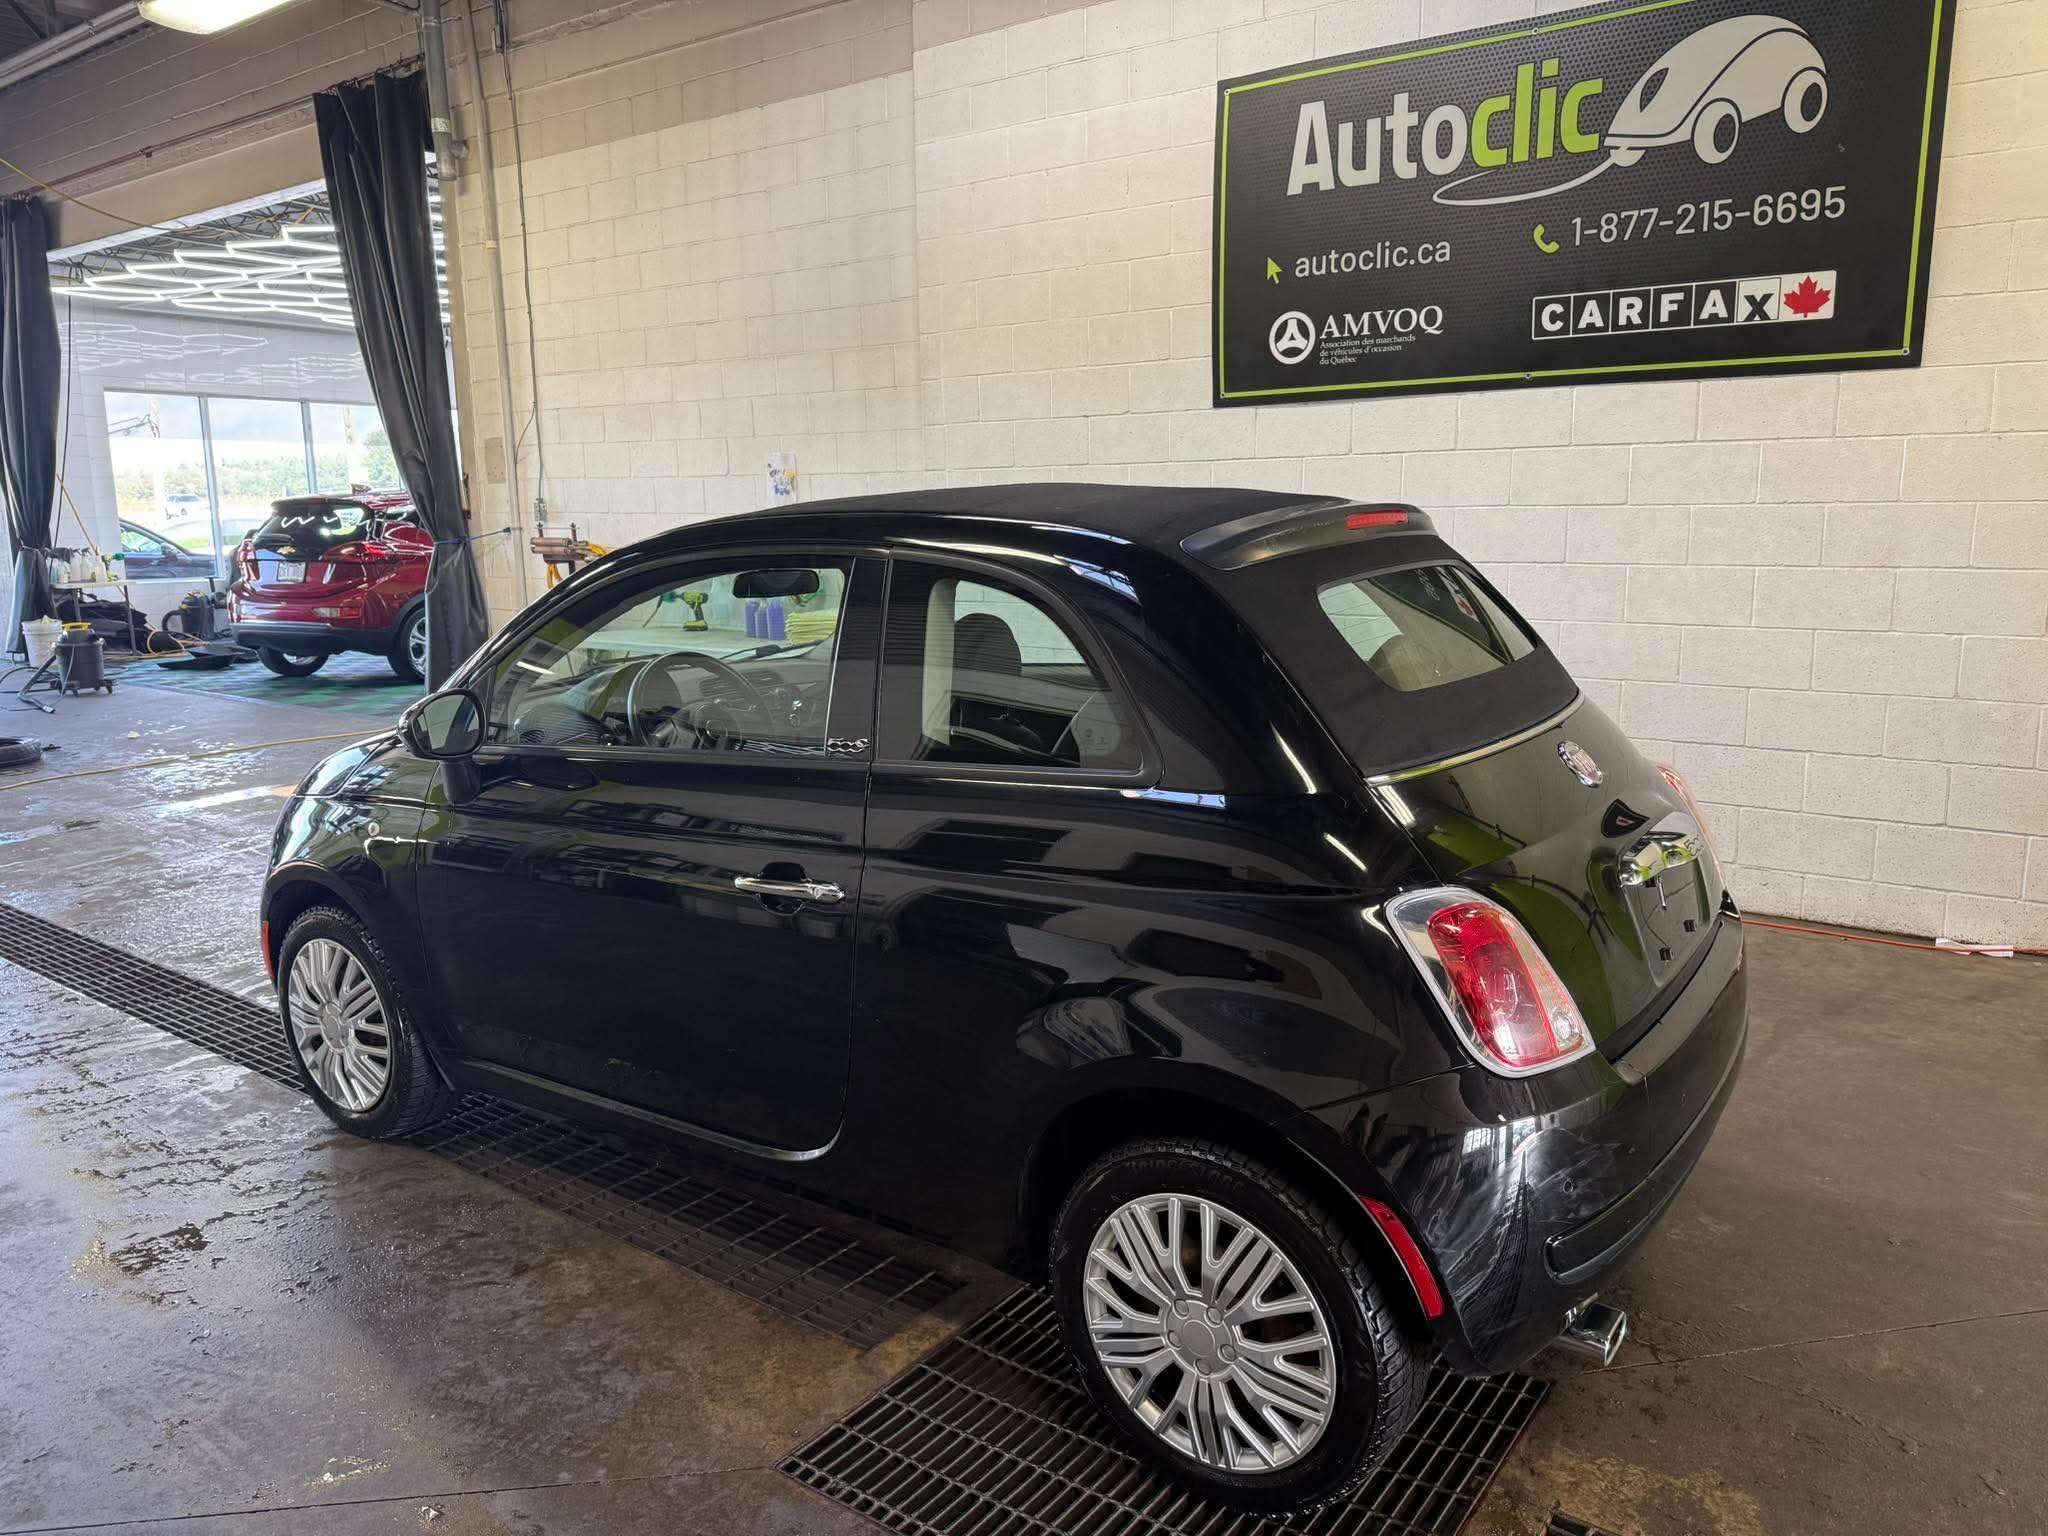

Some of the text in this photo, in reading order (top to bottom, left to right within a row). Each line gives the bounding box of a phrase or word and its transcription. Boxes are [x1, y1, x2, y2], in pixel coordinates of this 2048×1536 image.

[1286, 57, 1604, 196] Autoclic
[1570, 185, 1846, 246] 1-877-215-6695
[1294, 240, 1451, 278] autoclic.ca
[1319, 305, 1444, 339] AMVOQ
[1540, 289, 1775, 332] CARFAX
[1320, 334, 1416, 348] Association des marchands
[1320, 349, 1329, 357] de
[1320, 357, 1329, 365] du
